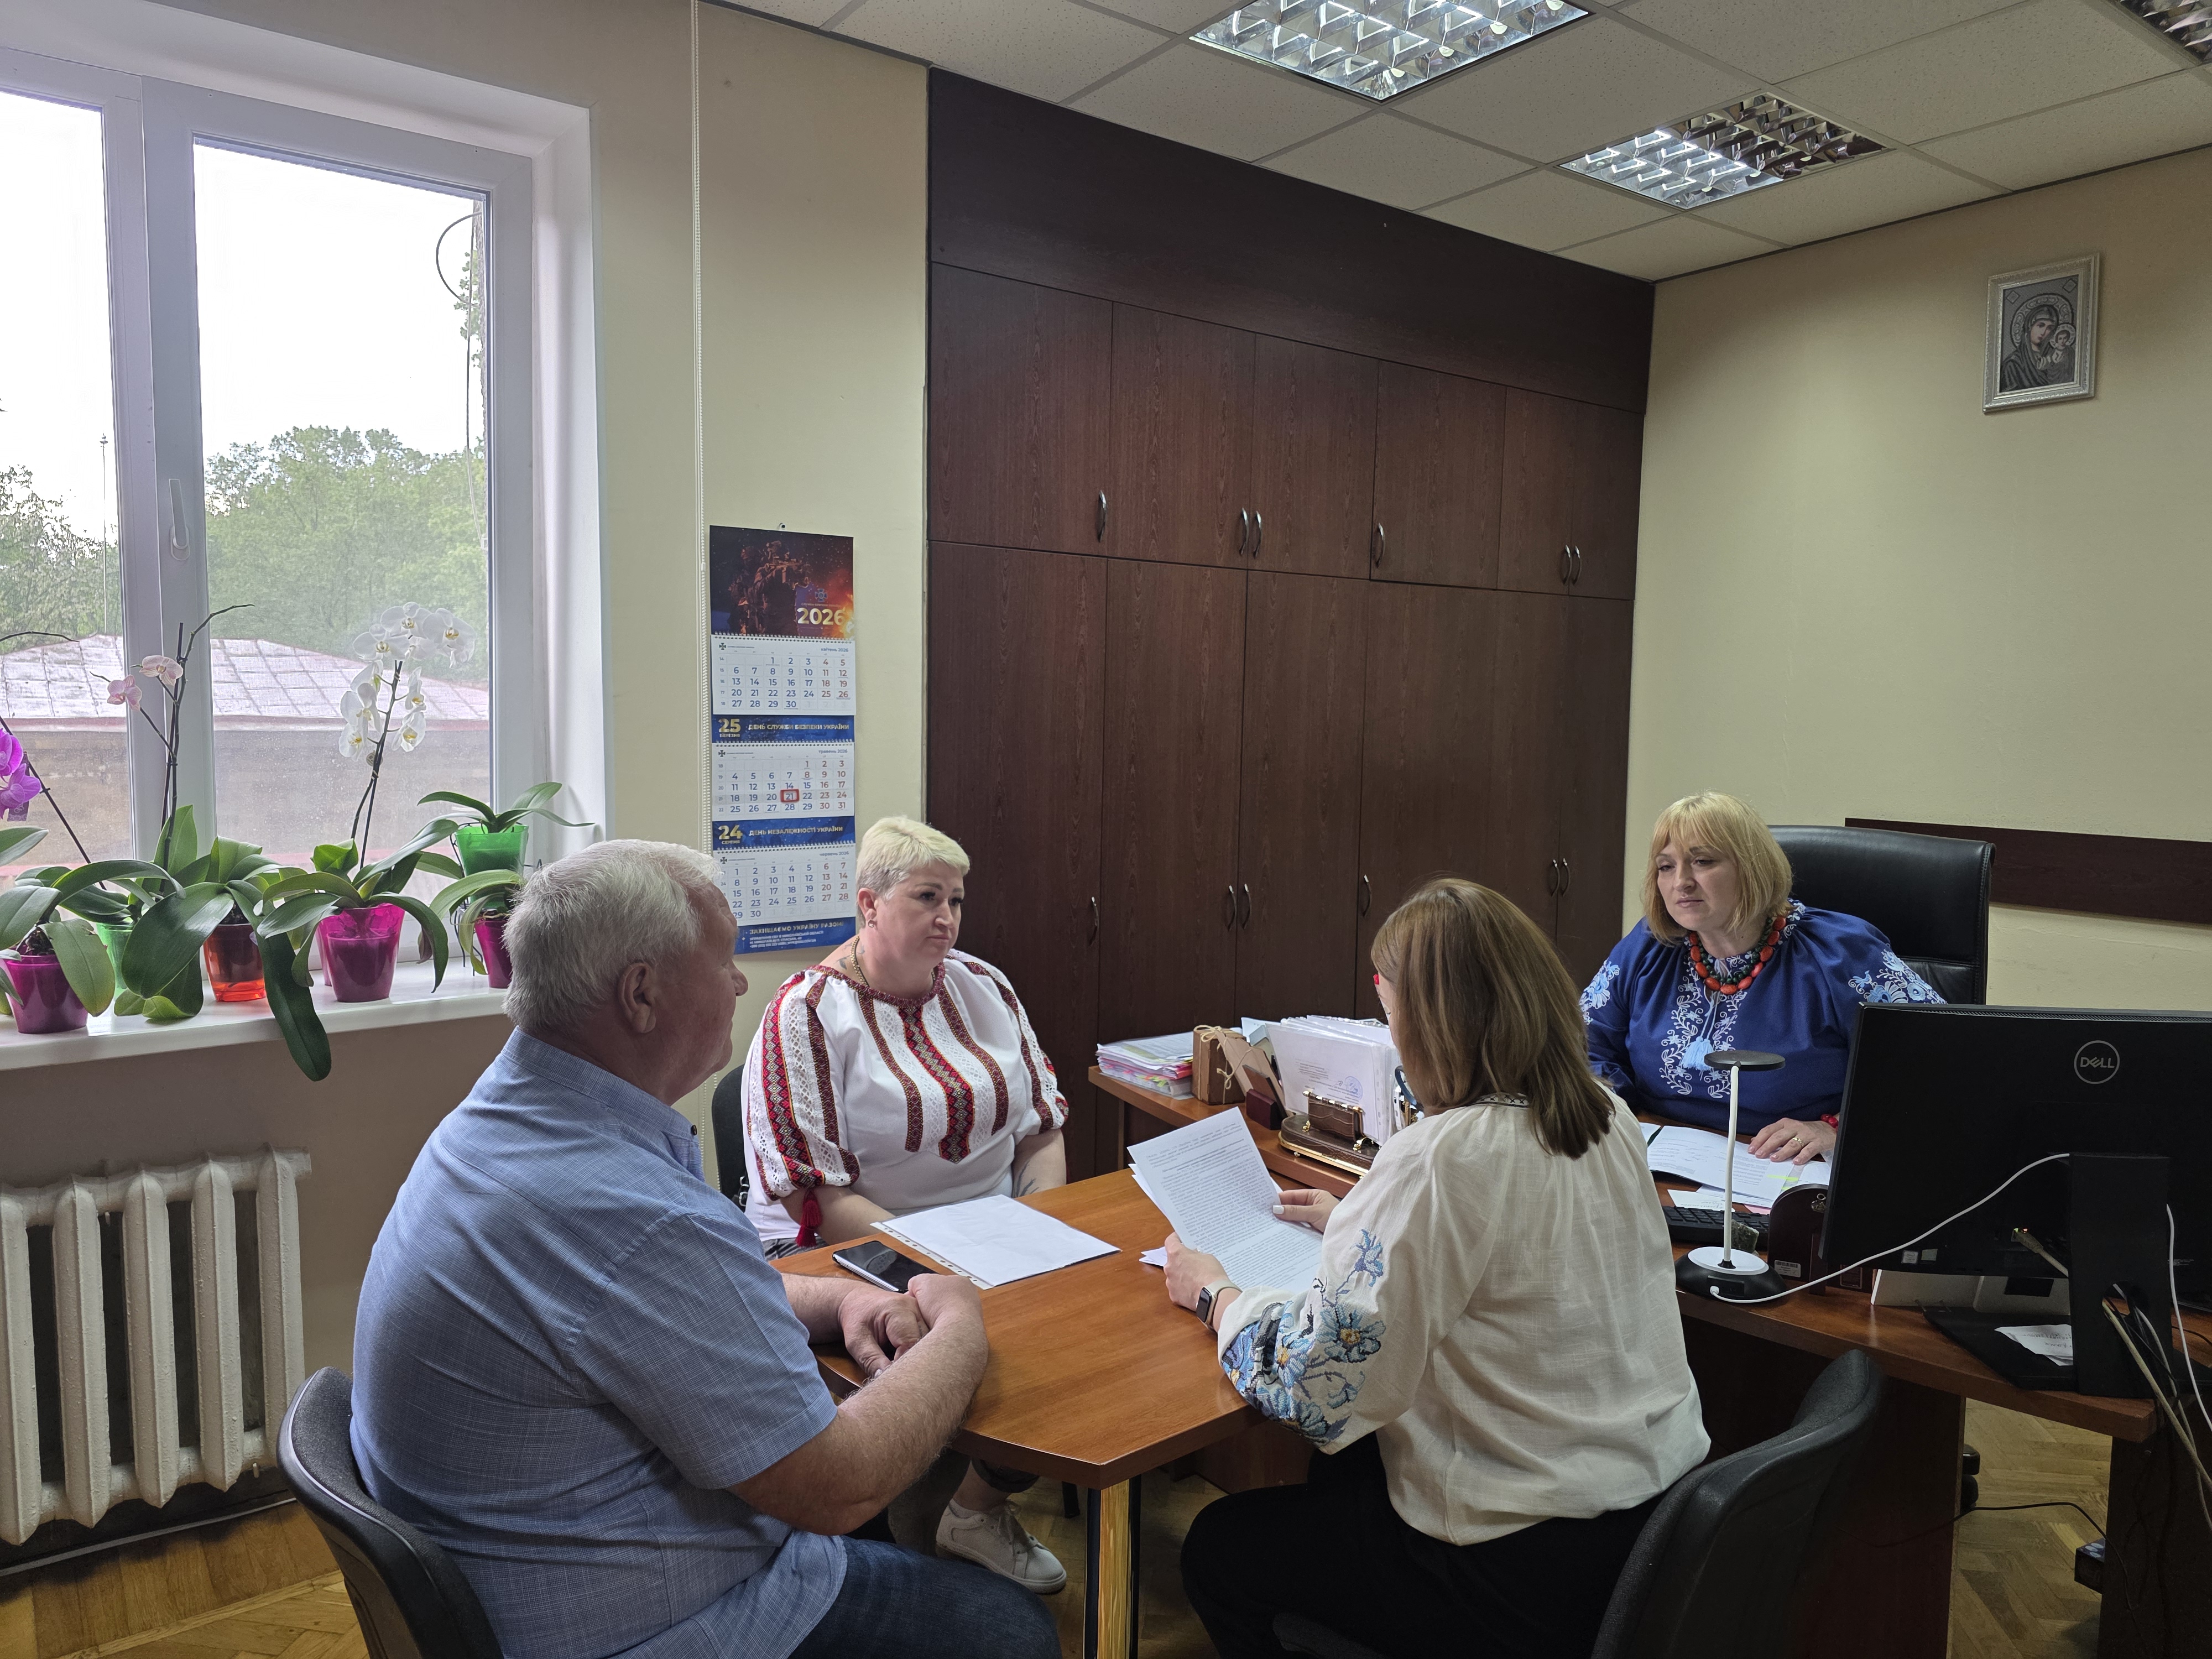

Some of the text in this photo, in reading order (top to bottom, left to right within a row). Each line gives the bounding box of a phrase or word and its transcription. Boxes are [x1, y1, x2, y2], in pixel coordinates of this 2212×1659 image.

[797, 608, 846, 625] 2026
[718, 719, 740, 733] 25
[718, 825, 743, 839] 24
[2080, 1057, 2115, 1068] DELL
